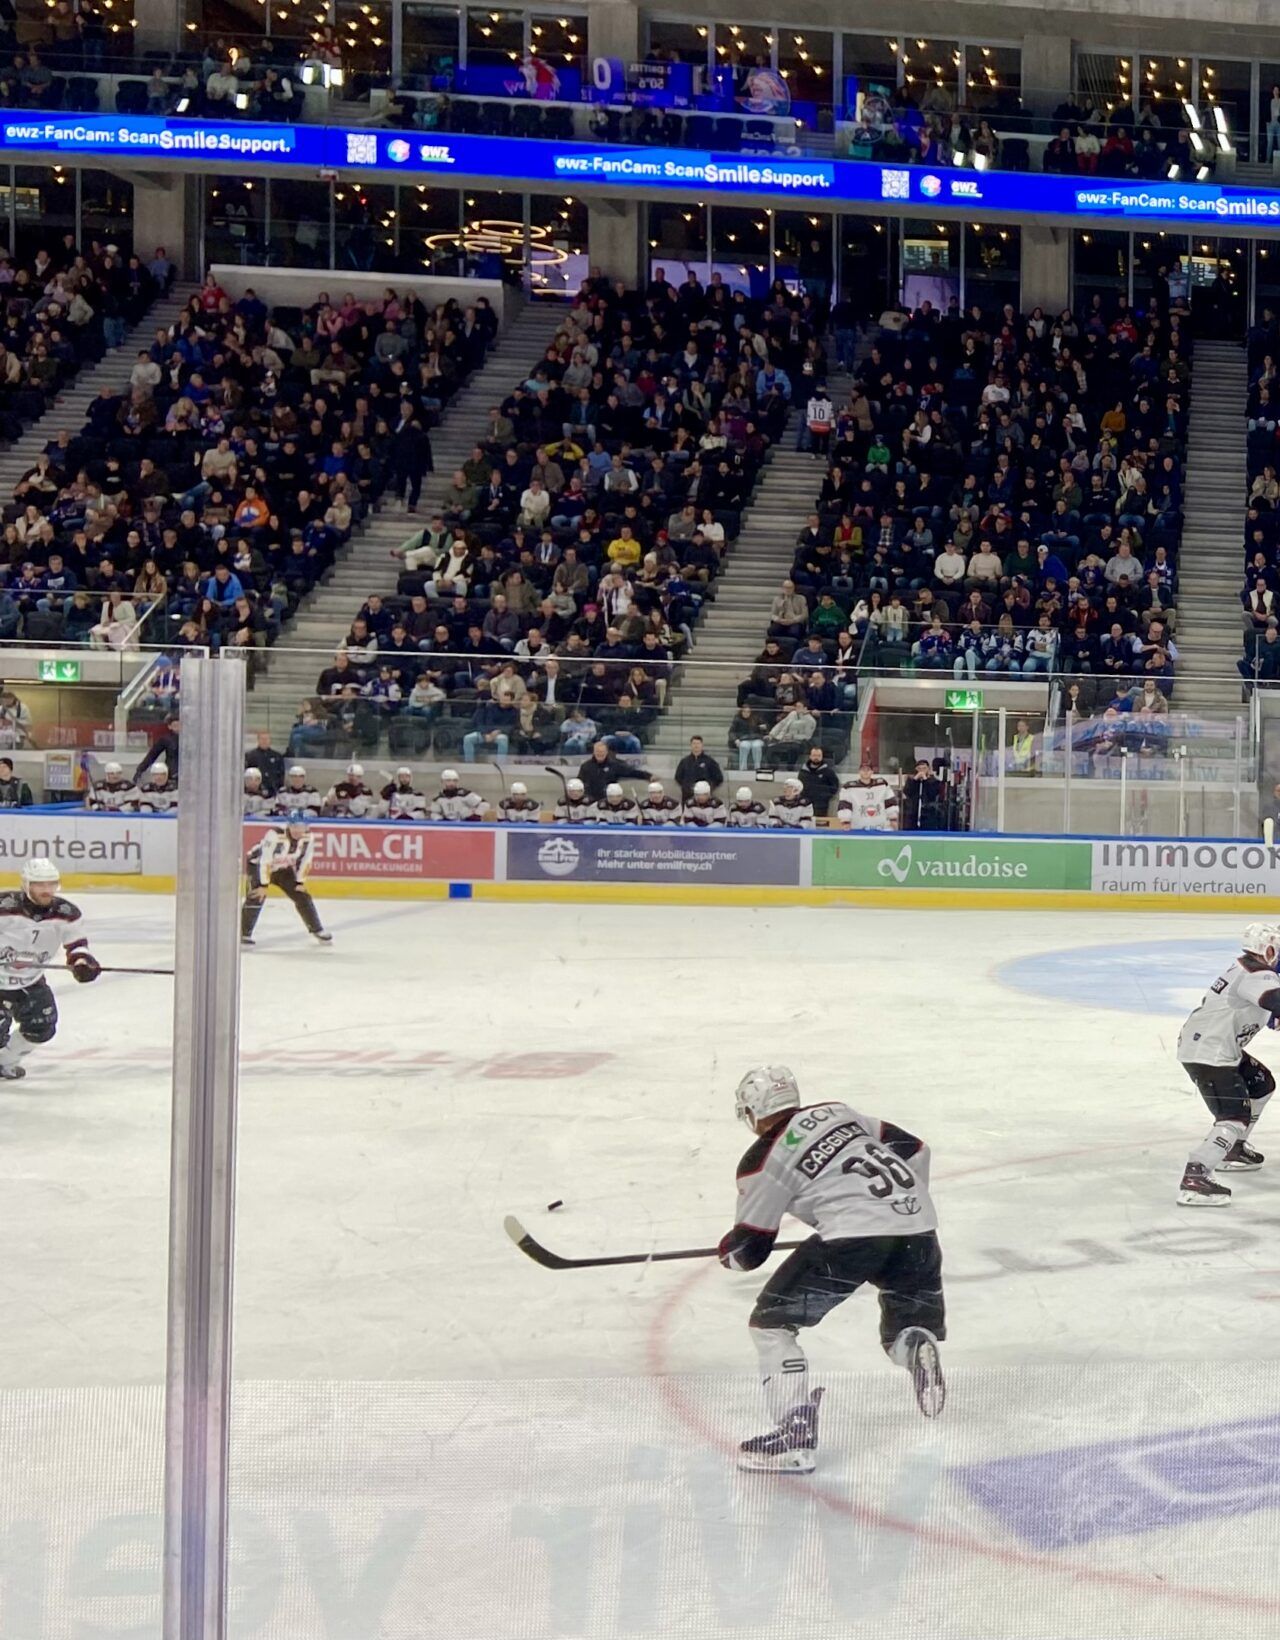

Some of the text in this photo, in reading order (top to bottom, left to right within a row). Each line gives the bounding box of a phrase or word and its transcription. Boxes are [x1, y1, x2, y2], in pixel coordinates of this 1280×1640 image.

[6, 125, 115, 142] ewz-FanCam:
[556, 157, 661, 175] ewz-FanCam:
[951, 181, 978, 193] ewz
[1078, 192, 1175, 208] ewz-FanCam:
[597, 848, 611, 859] Ihr
[614, 848, 648, 860] starker
[347, 861, 423, 873] VERPACKUNGEN
[597, 859, 712, 874] Mehr unter emilfrey.ch
[917, 854, 1028, 878] vaudoise
[1102, 877, 1267, 895] raum für vertrauen
[32, 930, 40, 944] 7
